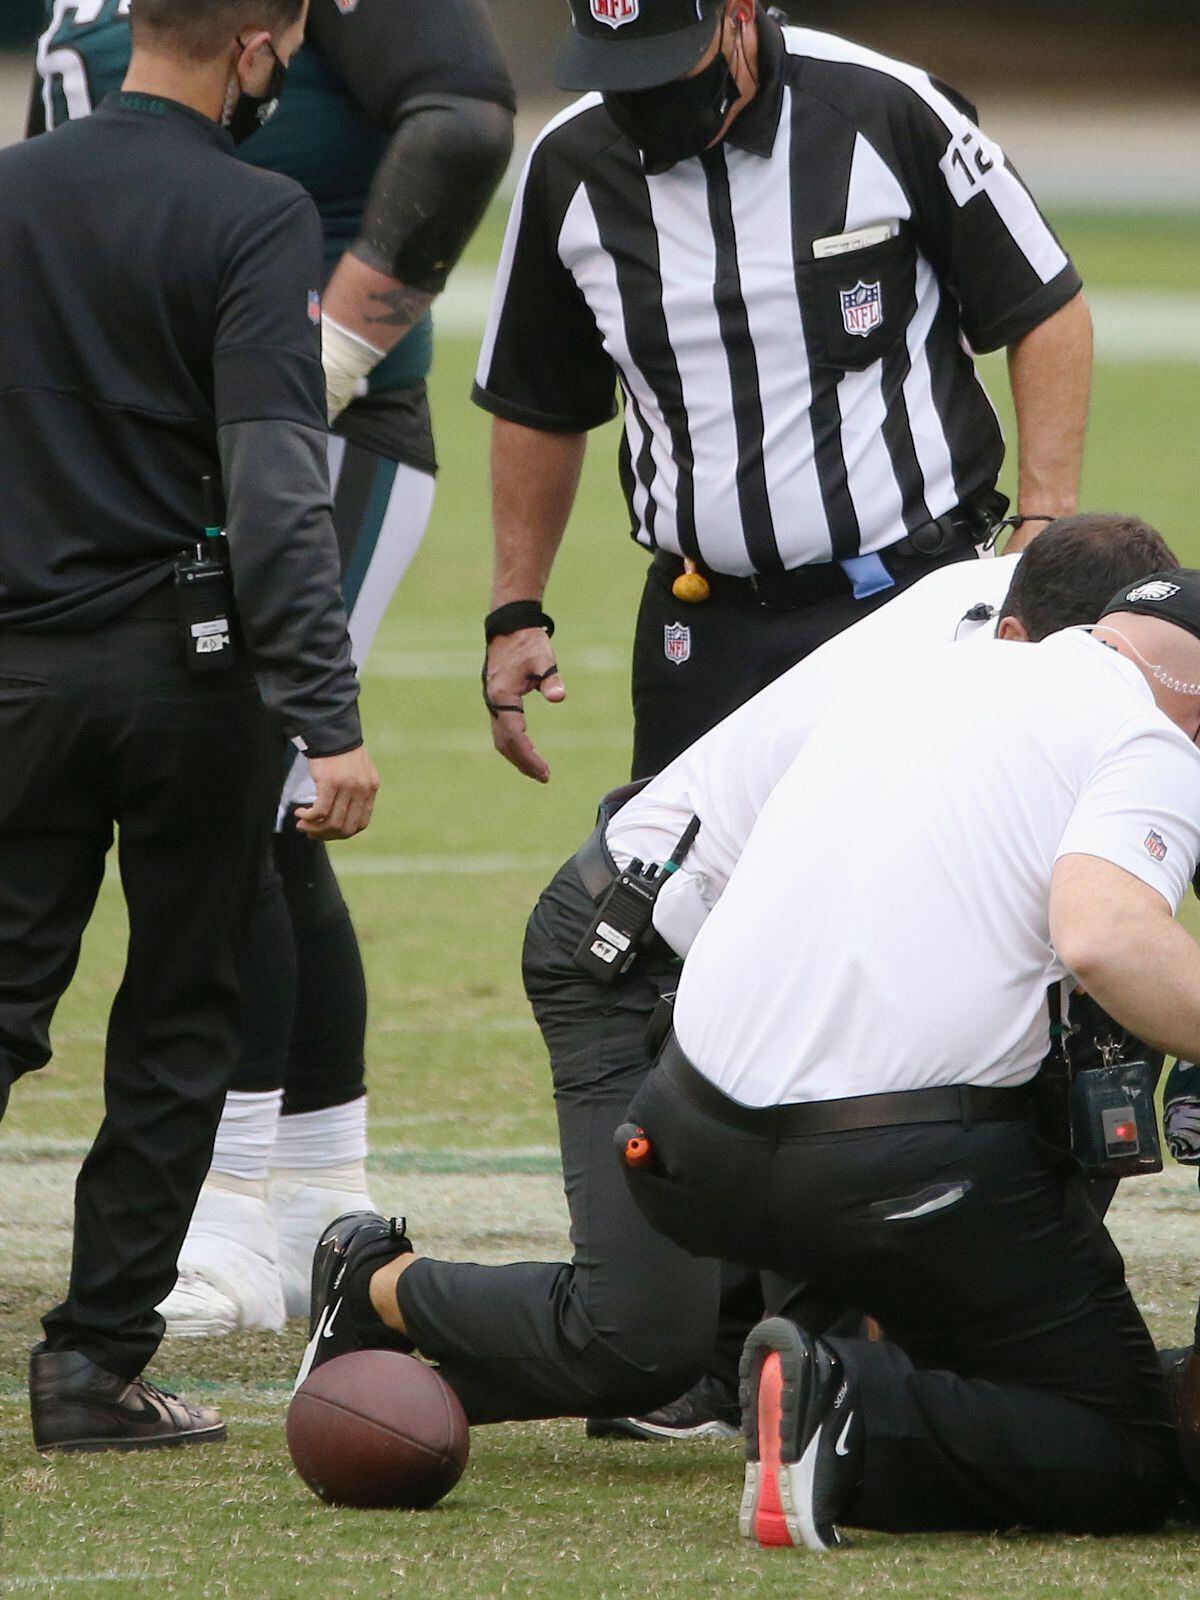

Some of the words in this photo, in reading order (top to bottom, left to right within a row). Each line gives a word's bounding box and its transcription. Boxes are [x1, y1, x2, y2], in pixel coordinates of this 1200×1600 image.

[950, 132, 994, 187] 12
[847, 304, 878, 328] NFL
[667, 641, 688, 657] NFL
